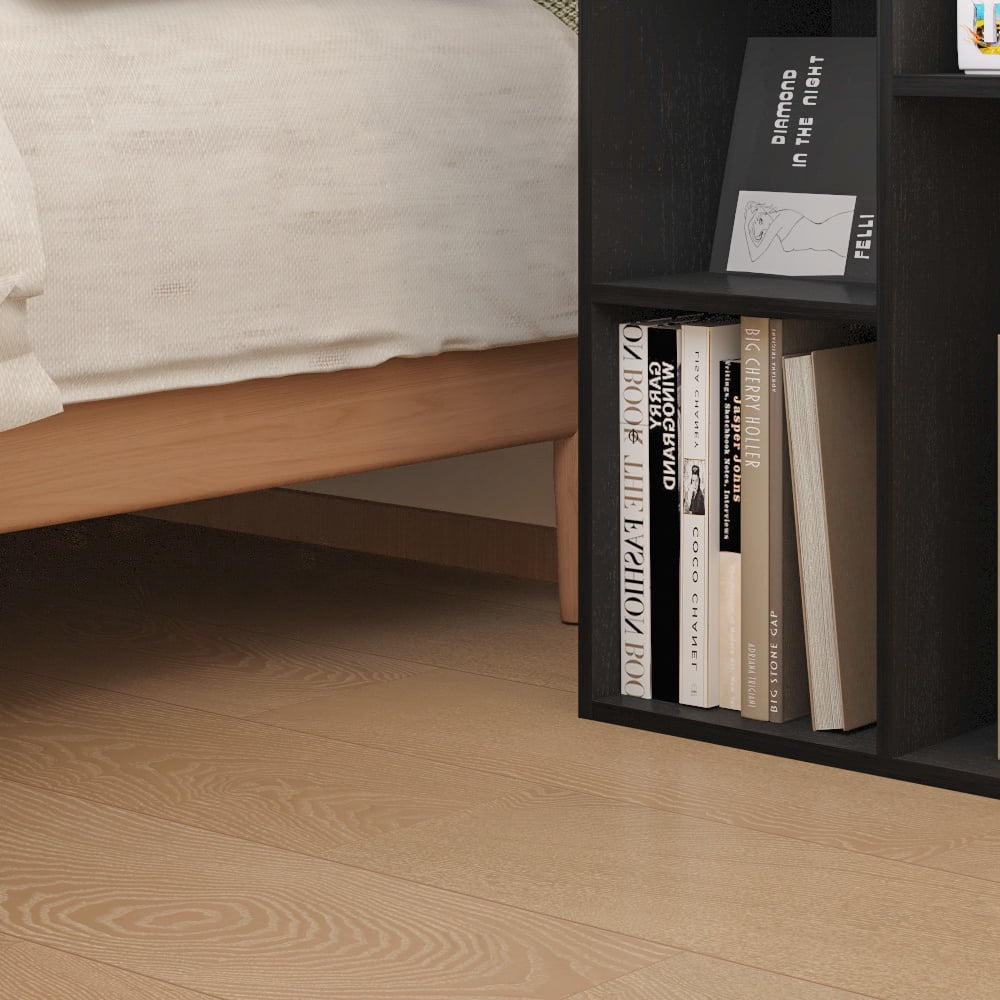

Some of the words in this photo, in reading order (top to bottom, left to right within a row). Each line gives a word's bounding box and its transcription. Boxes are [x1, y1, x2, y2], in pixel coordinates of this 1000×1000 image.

[803, 56, 824, 105] NIGHT
[771, 69, 797, 145] DIAMOND
[796, 118, 813, 145] THE
[792, 154, 807, 167] IN
[745, 329, 760, 351] BIG
[745, 358, 760, 410] CHERRY
[731, 395, 742, 450] Jasper
[745, 417, 760, 467] HOLLER
[733, 454, 742, 503] Johns
[770, 690, 778, 712] BIG
